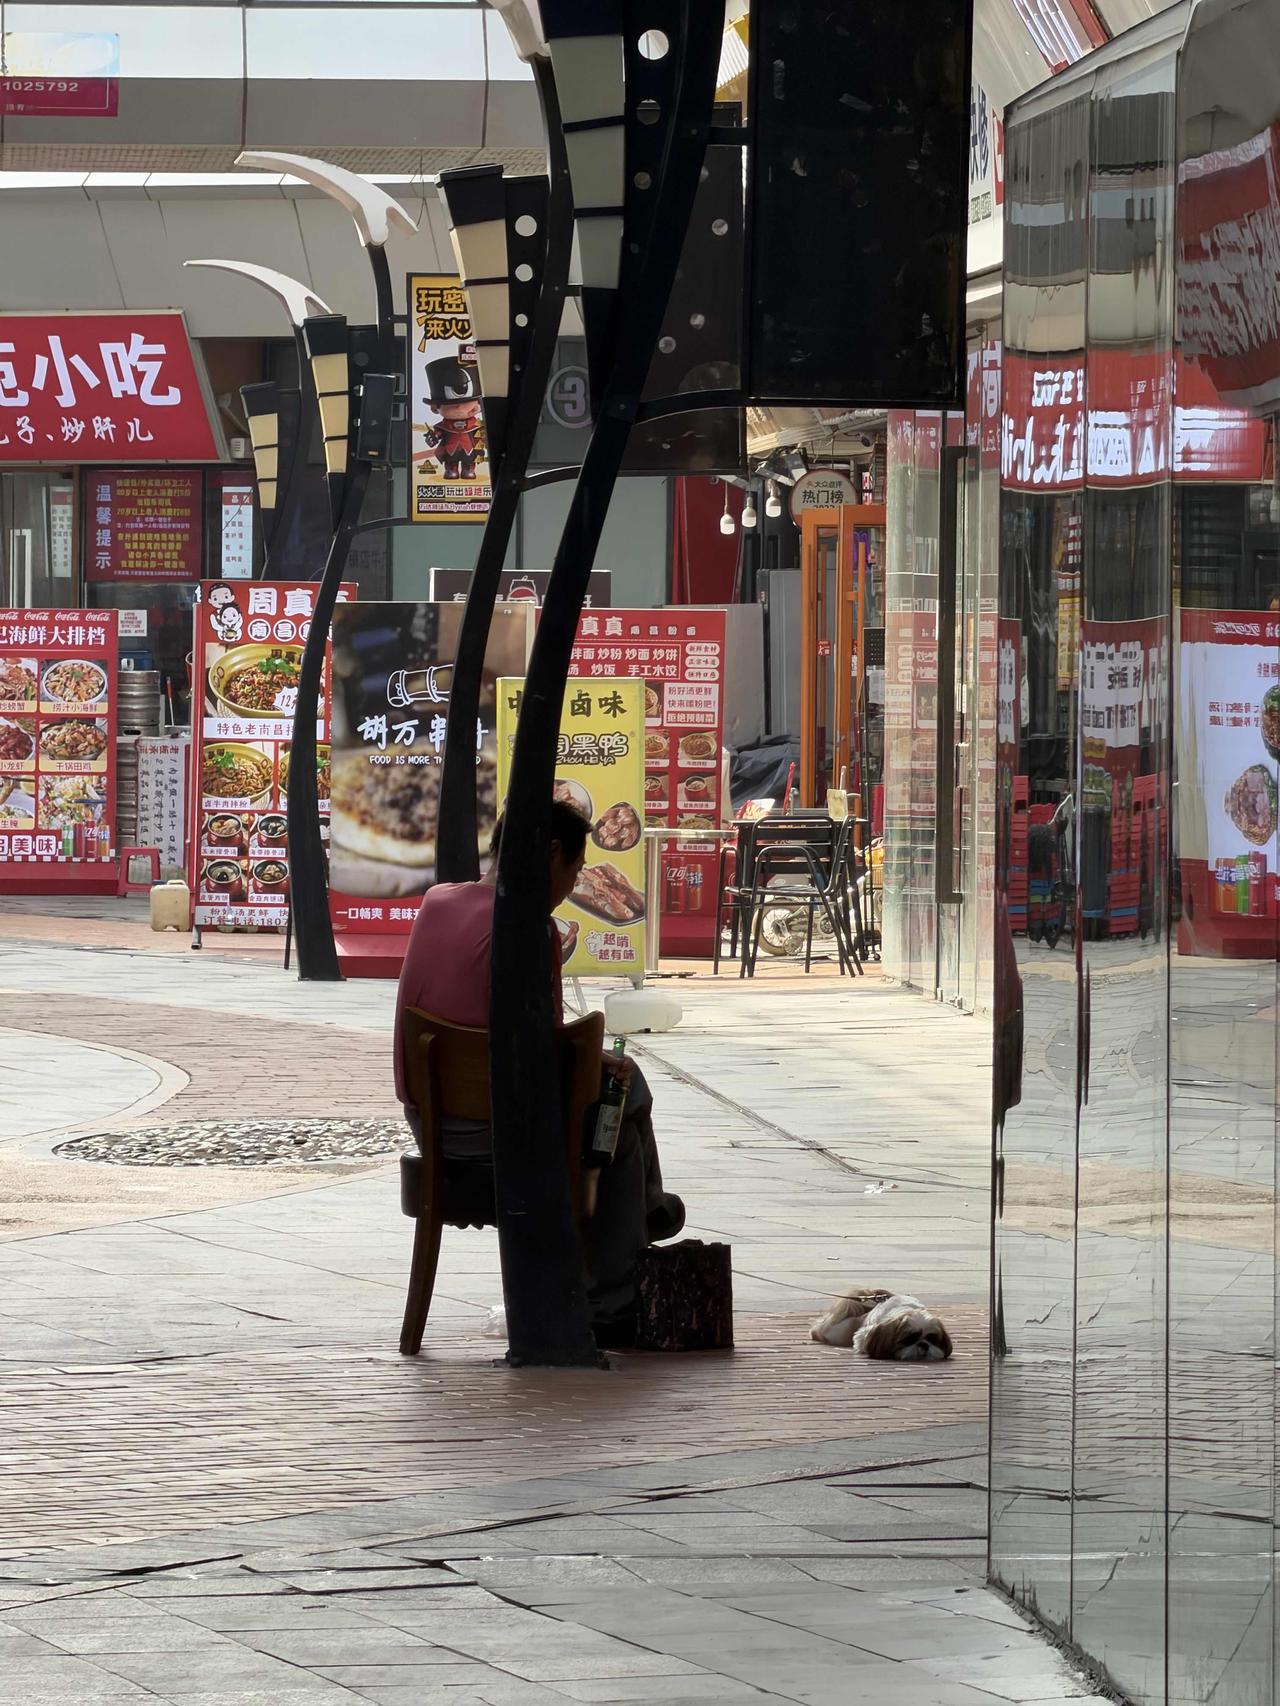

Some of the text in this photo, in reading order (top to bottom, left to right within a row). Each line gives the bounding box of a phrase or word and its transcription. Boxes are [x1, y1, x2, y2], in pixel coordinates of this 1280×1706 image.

[0, 416, 153, 444] 子、炒肝儿
[802, 490, 844, 504] 热门榜
[96, 485, 111, 569] 温馨提示
[581, 616, 623, 636] 真真
[598, 648, 622, 660] 炒粉
[625, 648, 650, 660] 炒面
[653, 648, 678, 661] 炒饼
[591, 664, 616, 676] 炒饭
[628, 664, 678, 677] 手工水饺
[56, 762, 91, 771] 干锅田鸡
[369, 755, 391, 765] FOOD
[395, 755, 405, 765] IS
[408, 755, 430, 765] MORE
[336, 907, 383, 919] 一口畅爽
[604, 932, 629, 948] 越啃
[599, 949, 635, 960] 越有味
